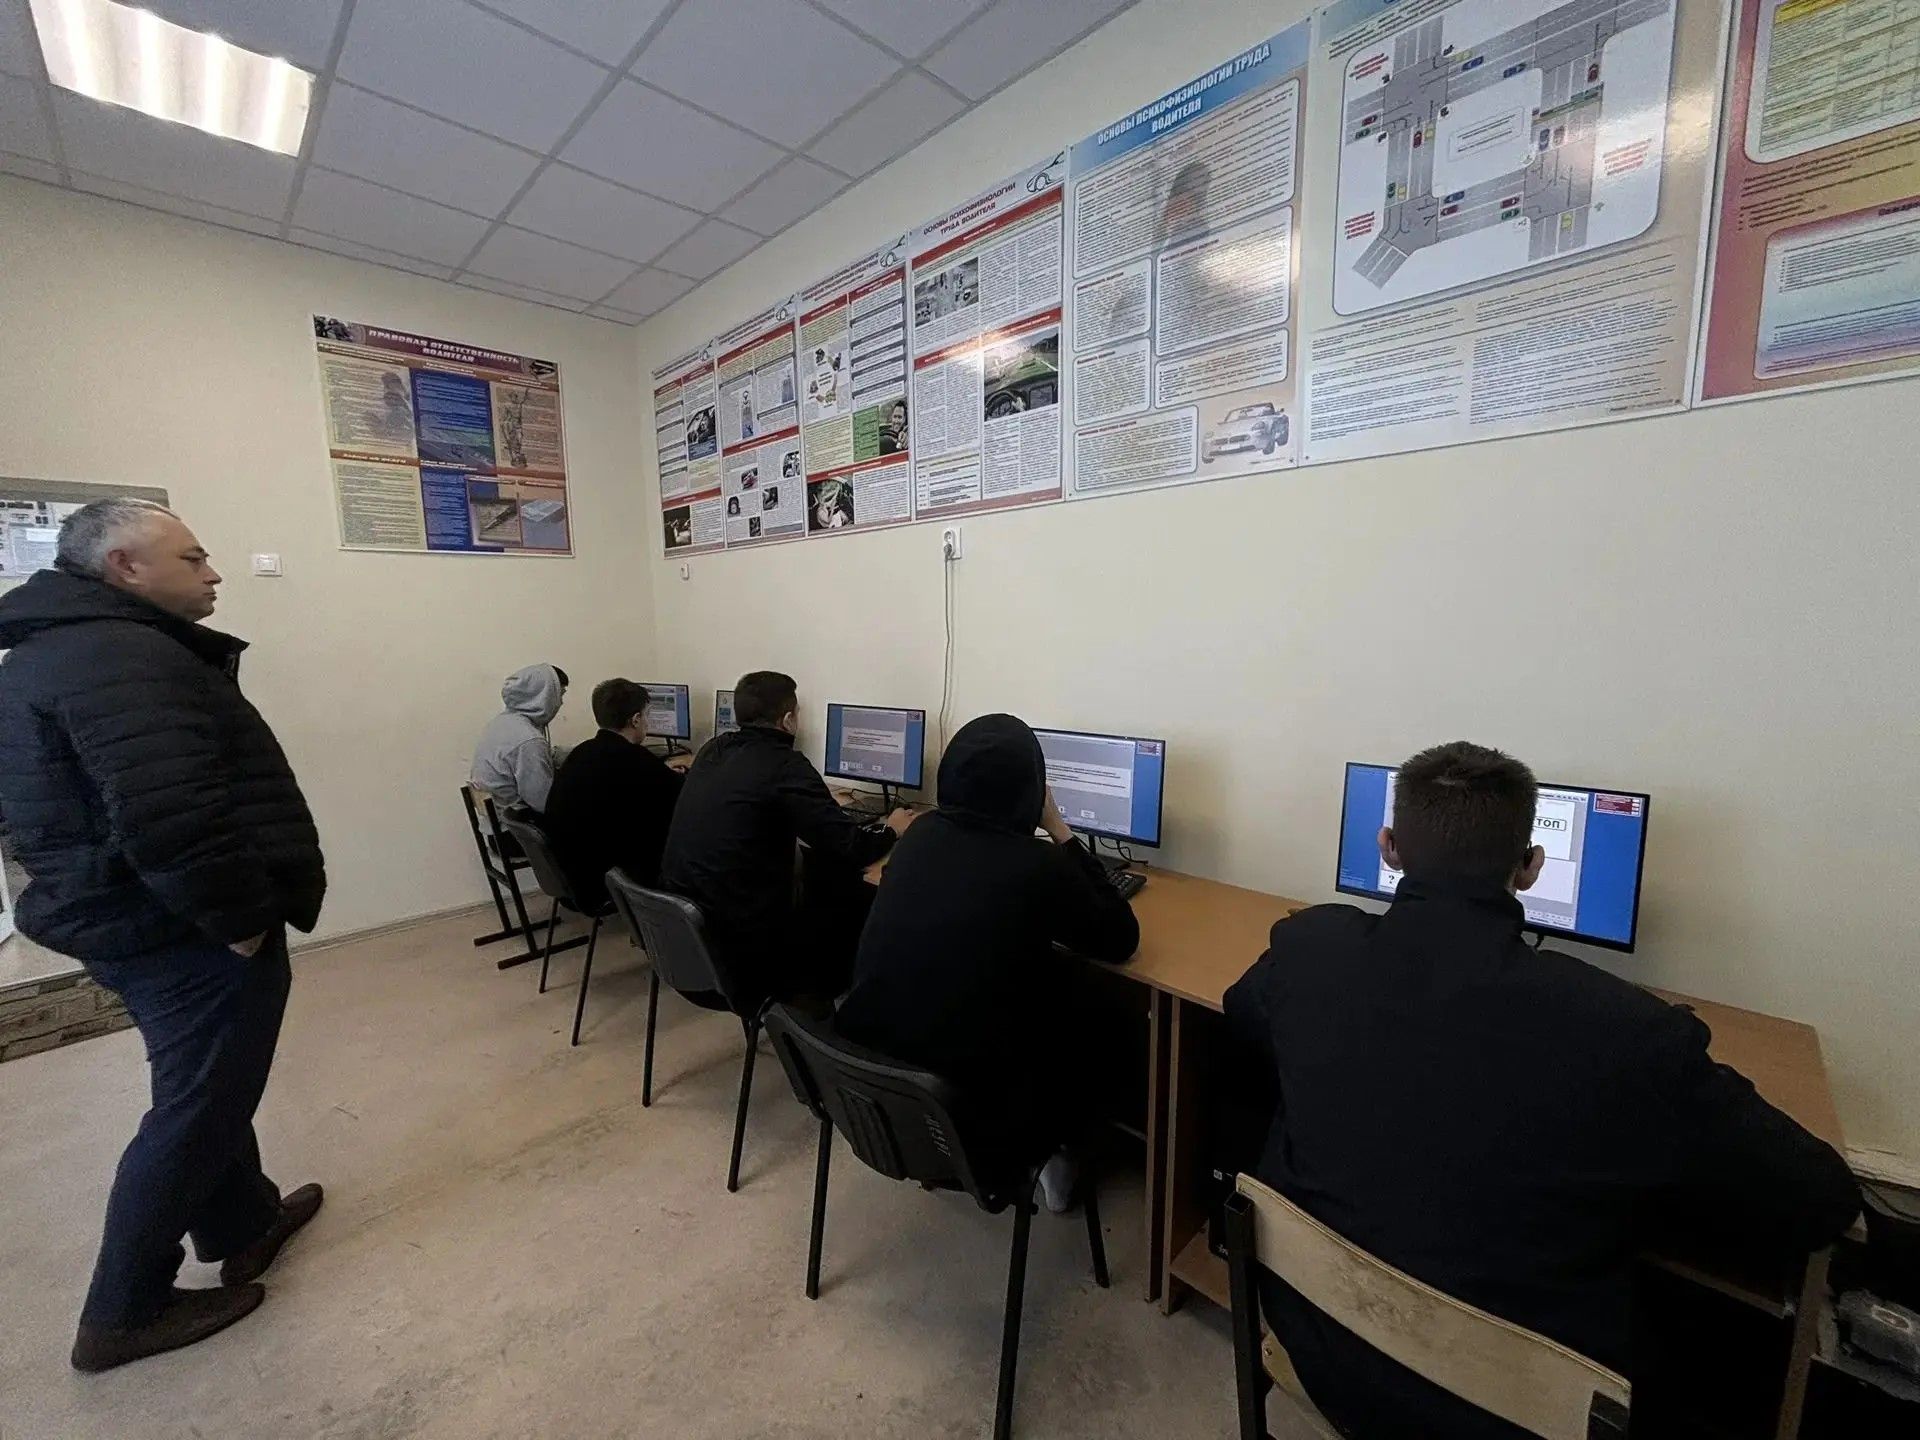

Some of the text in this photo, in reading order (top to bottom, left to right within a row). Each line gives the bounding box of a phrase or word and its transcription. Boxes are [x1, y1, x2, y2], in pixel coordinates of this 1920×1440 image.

[1097, 43, 1271, 146] ОСНОВЫ ПСИХОФИЗИОЛОГИИ ТРУДА
[1151, 98, 1201, 133] ВОДИТЕЛЯ
[923, 216, 949, 235] ОСНОВЫ
[961, 202, 996, 224] ВОДИТЕЛЯ
[368, 330, 519, 363] ПРАВОВАЯ ОТВЕТСТВЕННОСТЬ
[422, 347, 475, 363] ВОДИТЕЛЯ
